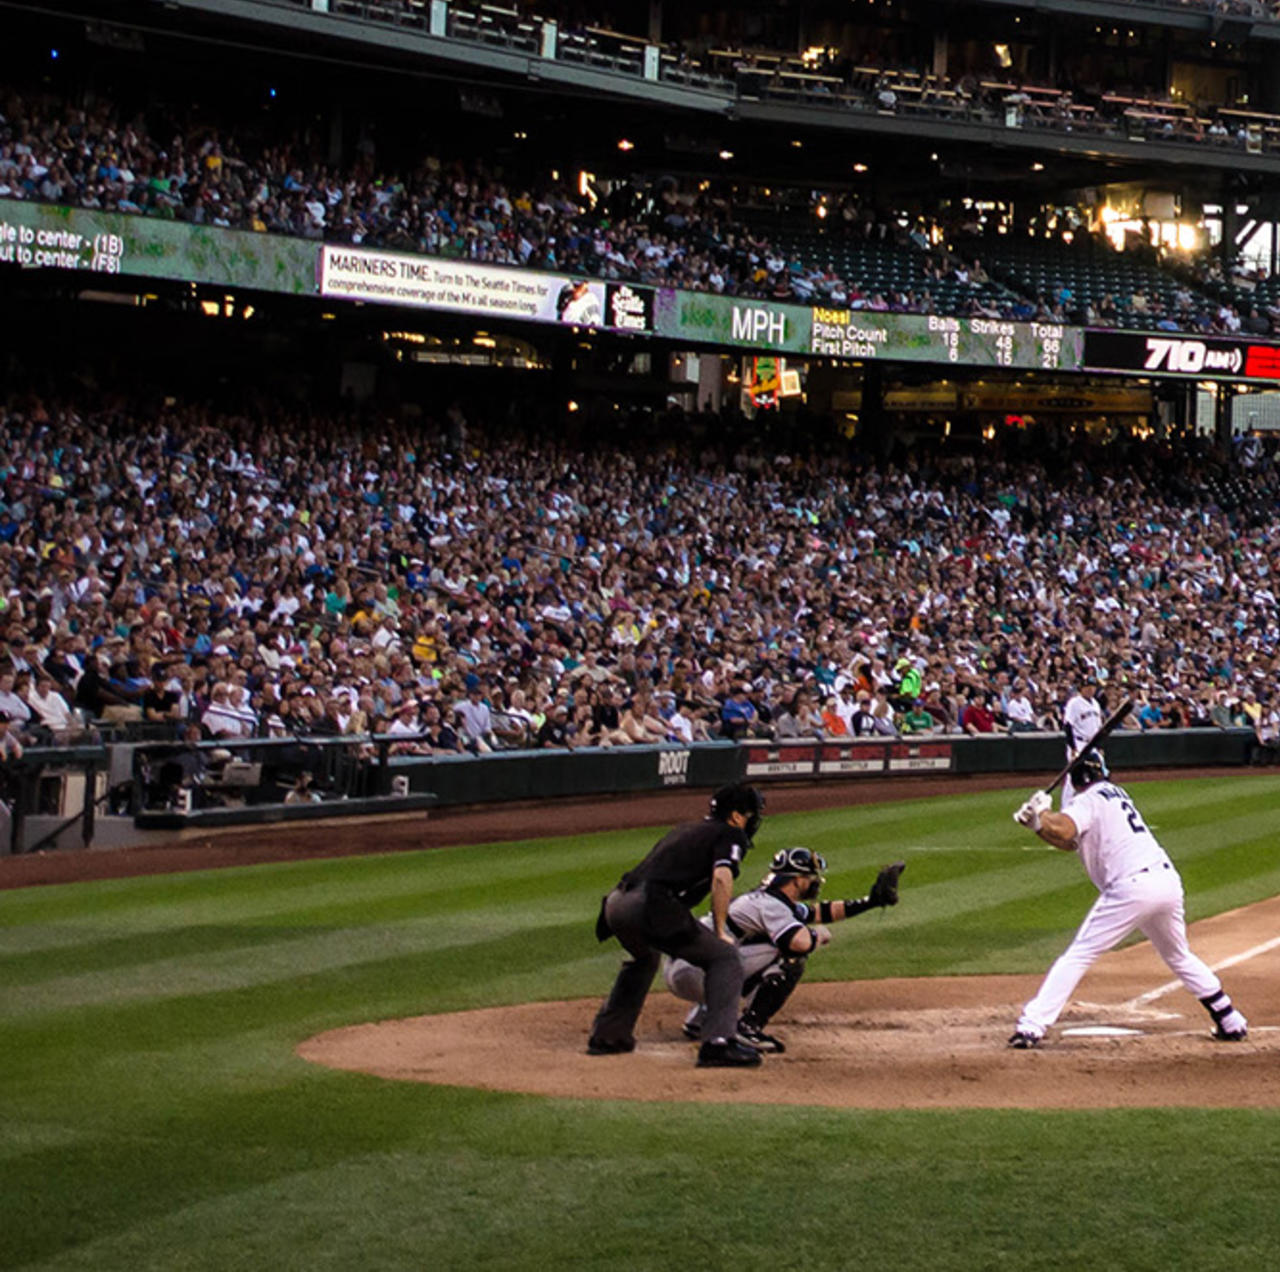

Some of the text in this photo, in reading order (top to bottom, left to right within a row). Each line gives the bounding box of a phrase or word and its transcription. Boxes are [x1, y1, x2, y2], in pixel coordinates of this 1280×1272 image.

[37, 229, 82, 249] center
[35, 249, 80, 269] center
[330, 254, 397, 278] MARINERS
[328, 278, 395, 296] comprehensive
[397, 286, 435, 303] coverage
[732, 306, 785, 345] MPH
[813, 323, 888, 343] Pitch Count
[928, 316, 1064, 339] Balls Strikes Total
[812, 338, 876, 357] First Pitch
[1144, 338, 1206, 373] 710
[1042, 354, 1059, 369] 21
[658, 751, 691, 775] ROOT
